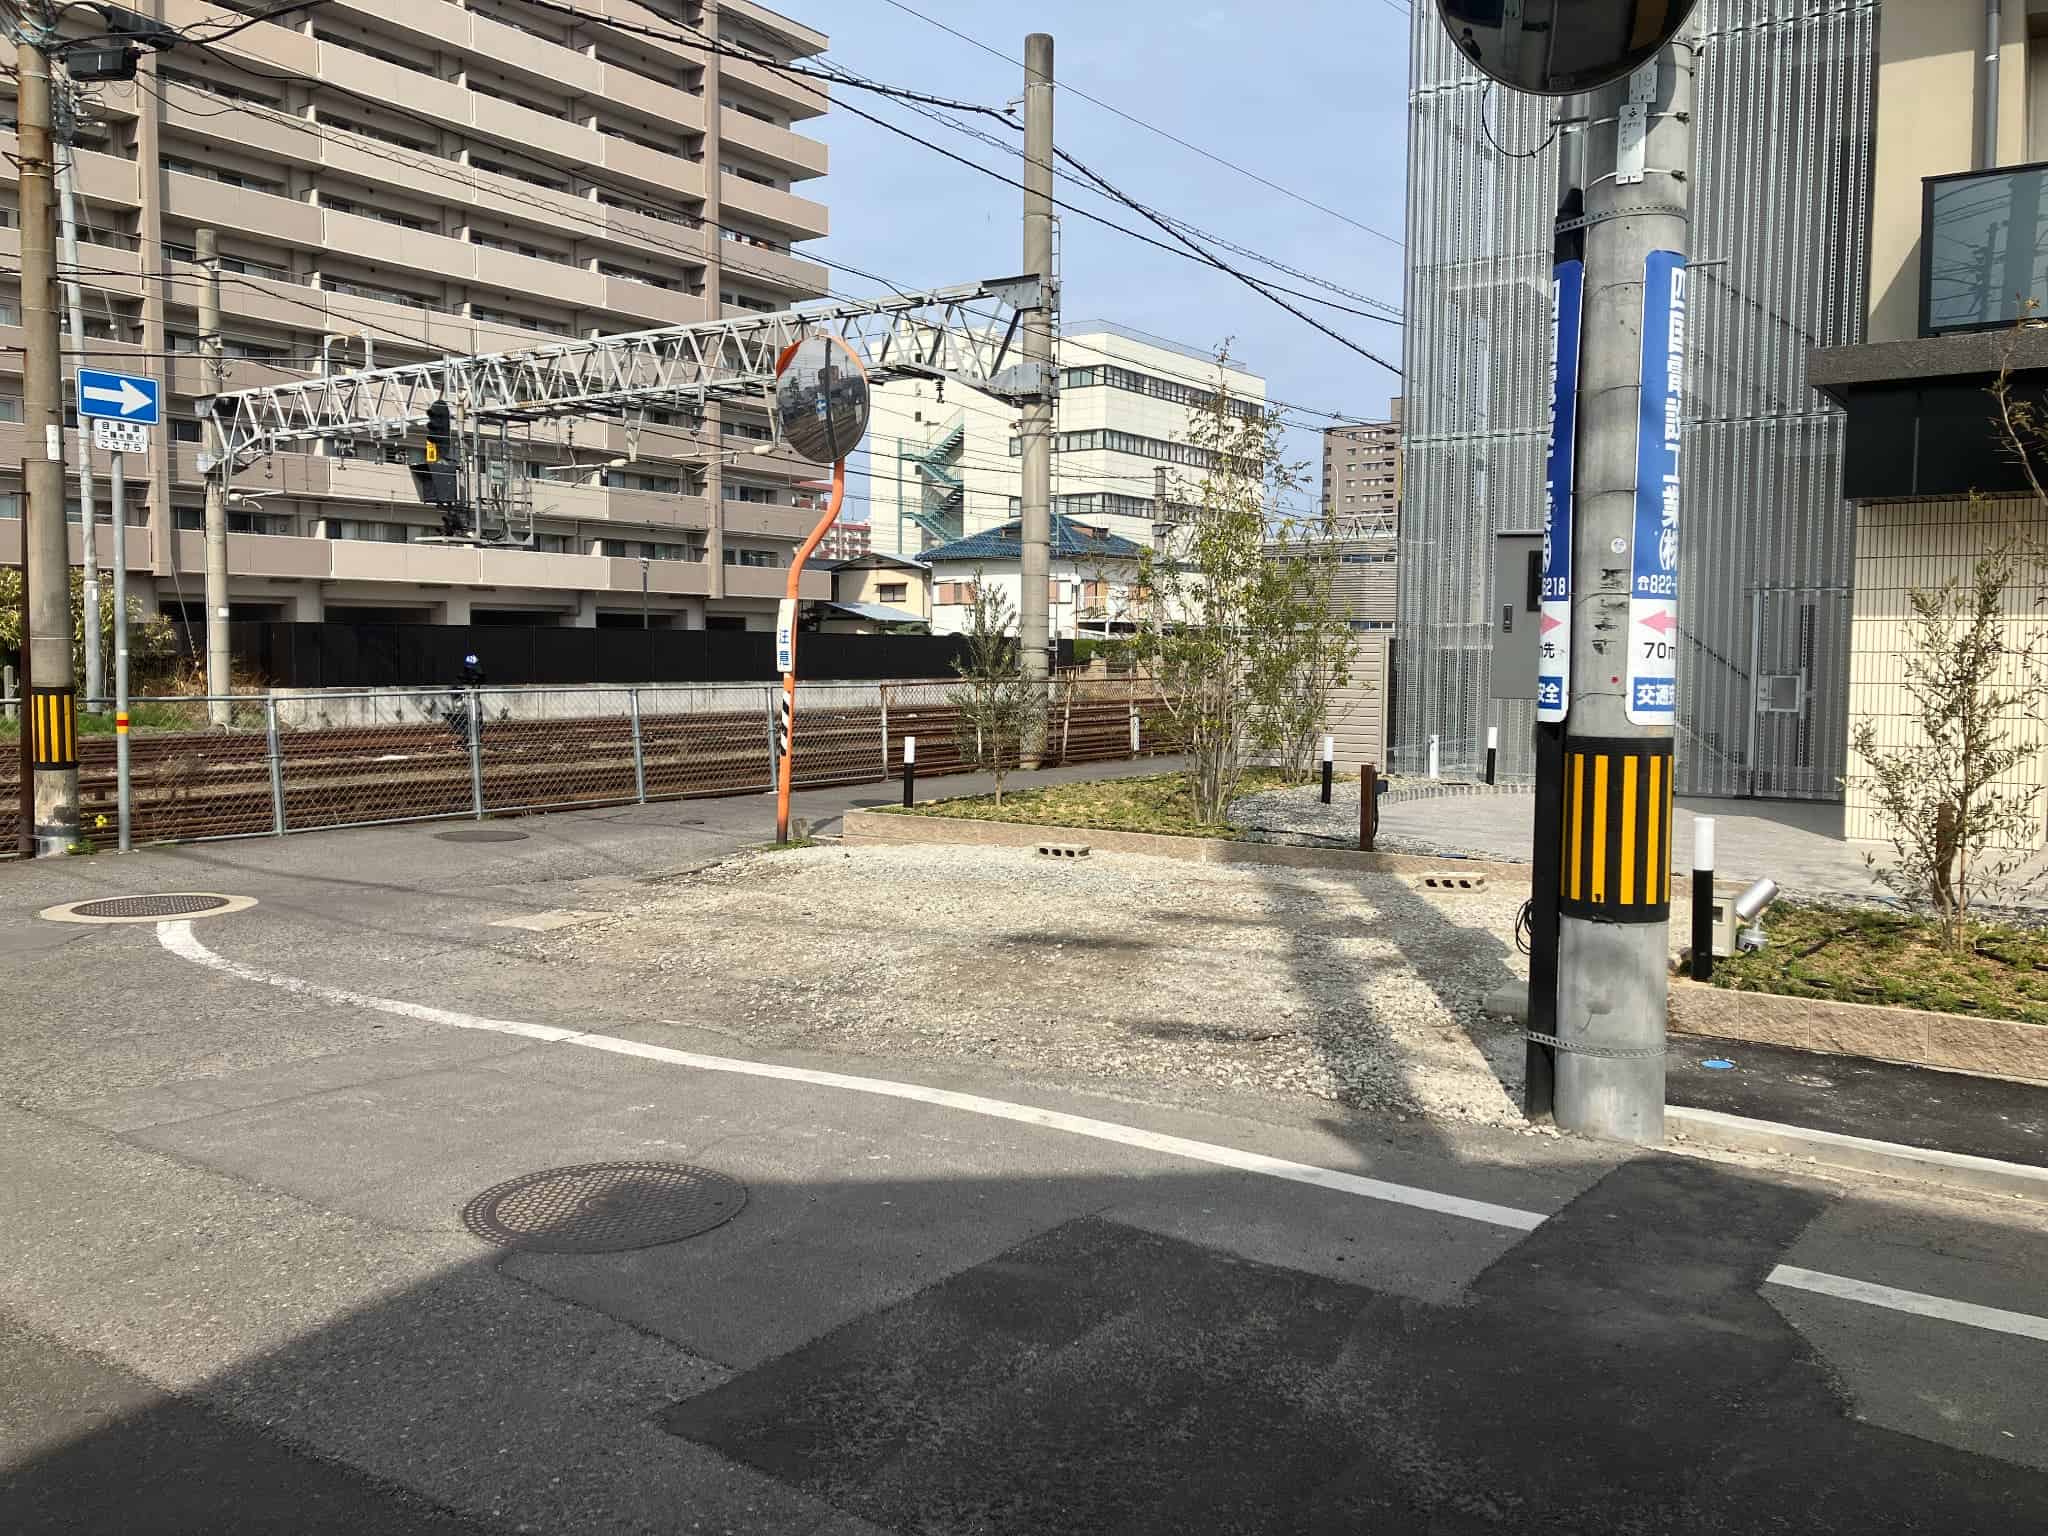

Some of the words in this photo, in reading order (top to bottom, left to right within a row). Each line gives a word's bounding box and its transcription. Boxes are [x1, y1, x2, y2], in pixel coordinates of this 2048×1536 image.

[101, 439, 142, 452] ここから
[779, 629, 790, 665] 注意
